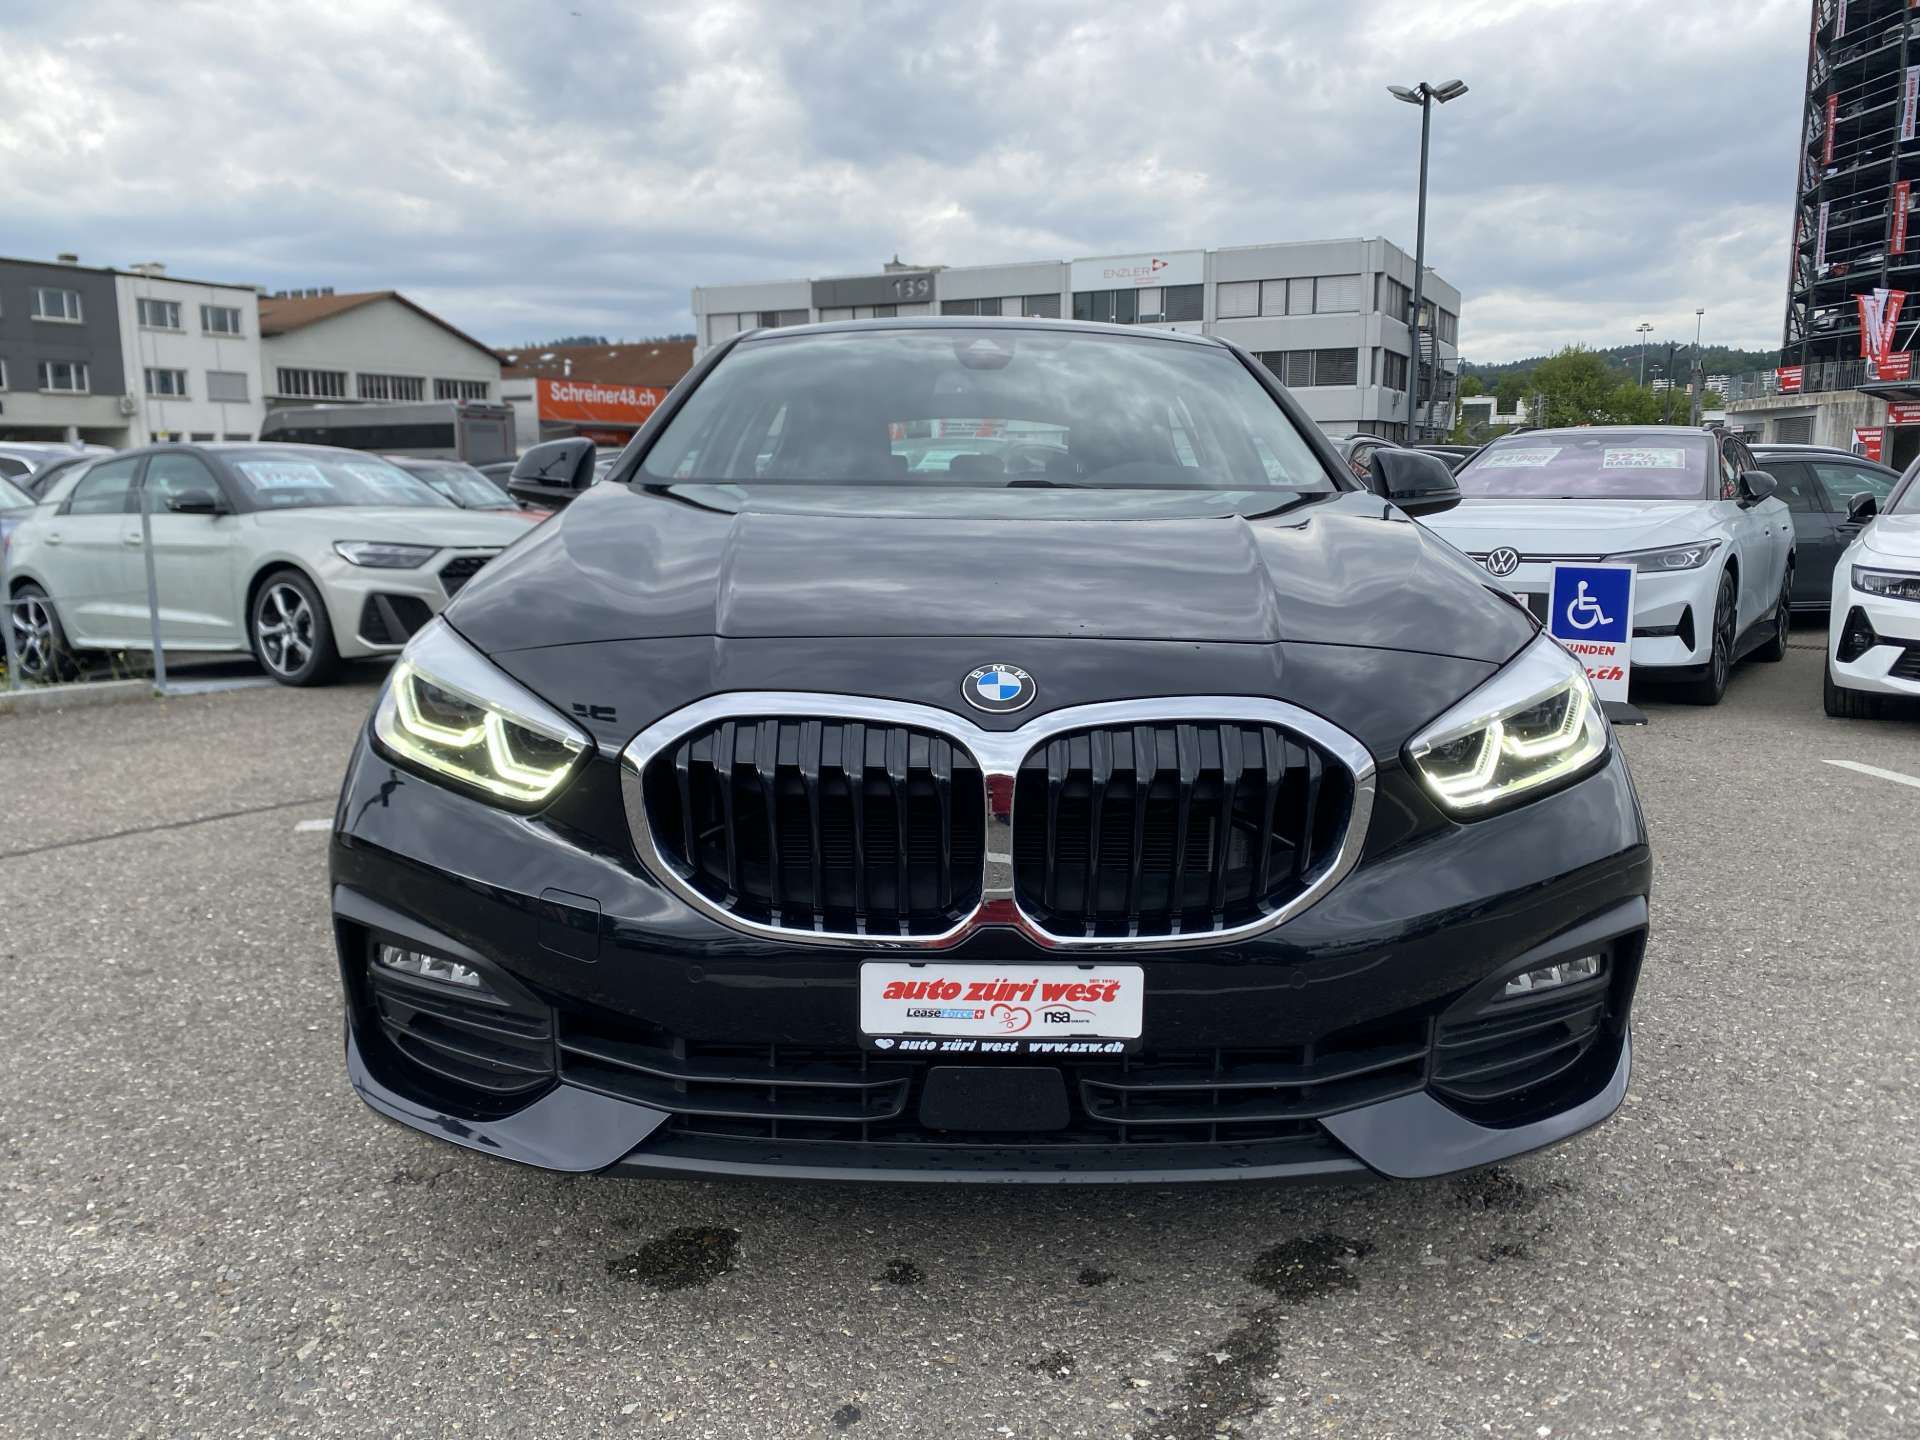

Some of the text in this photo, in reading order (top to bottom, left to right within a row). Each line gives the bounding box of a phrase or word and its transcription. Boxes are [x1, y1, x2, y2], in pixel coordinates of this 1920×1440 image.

[1104, 267, 1151, 279] ENZLER
[892, 279, 929, 297] 139
[550, 382, 656, 406] Schreiner48.ch
[883, 978, 1121, 1002] auto züri west
[906, 1008, 974, 1019] LeaseForce
[1044, 1011, 1070, 1023] nsa
[899, 1039, 1124, 1053] auto züri west www.azw.ch
